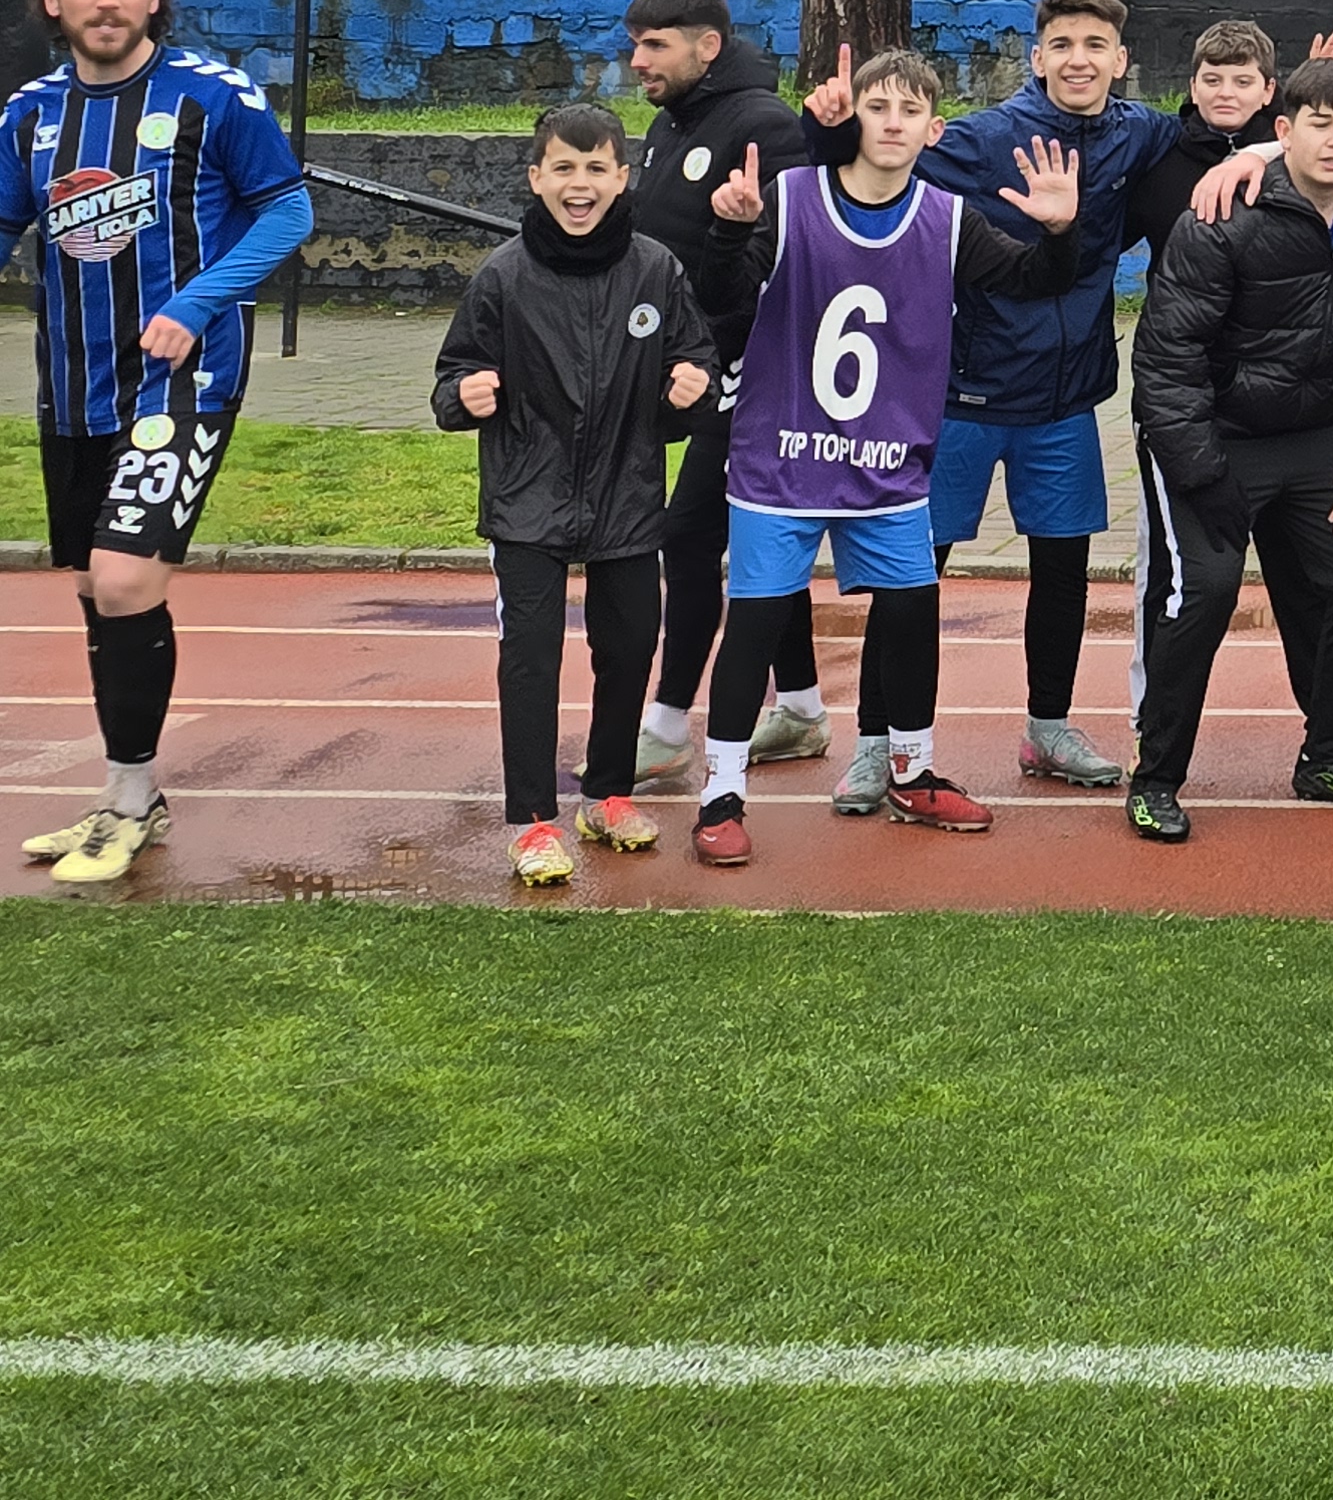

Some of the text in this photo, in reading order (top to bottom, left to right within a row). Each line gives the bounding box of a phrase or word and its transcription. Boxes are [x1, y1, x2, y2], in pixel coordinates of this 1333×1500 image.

[47, 178, 152, 235] SARIYER
[97, 208, 154, 241] KOLA
[811, 284, 888, 422] 6
[108, 450, 181, 505] 23
